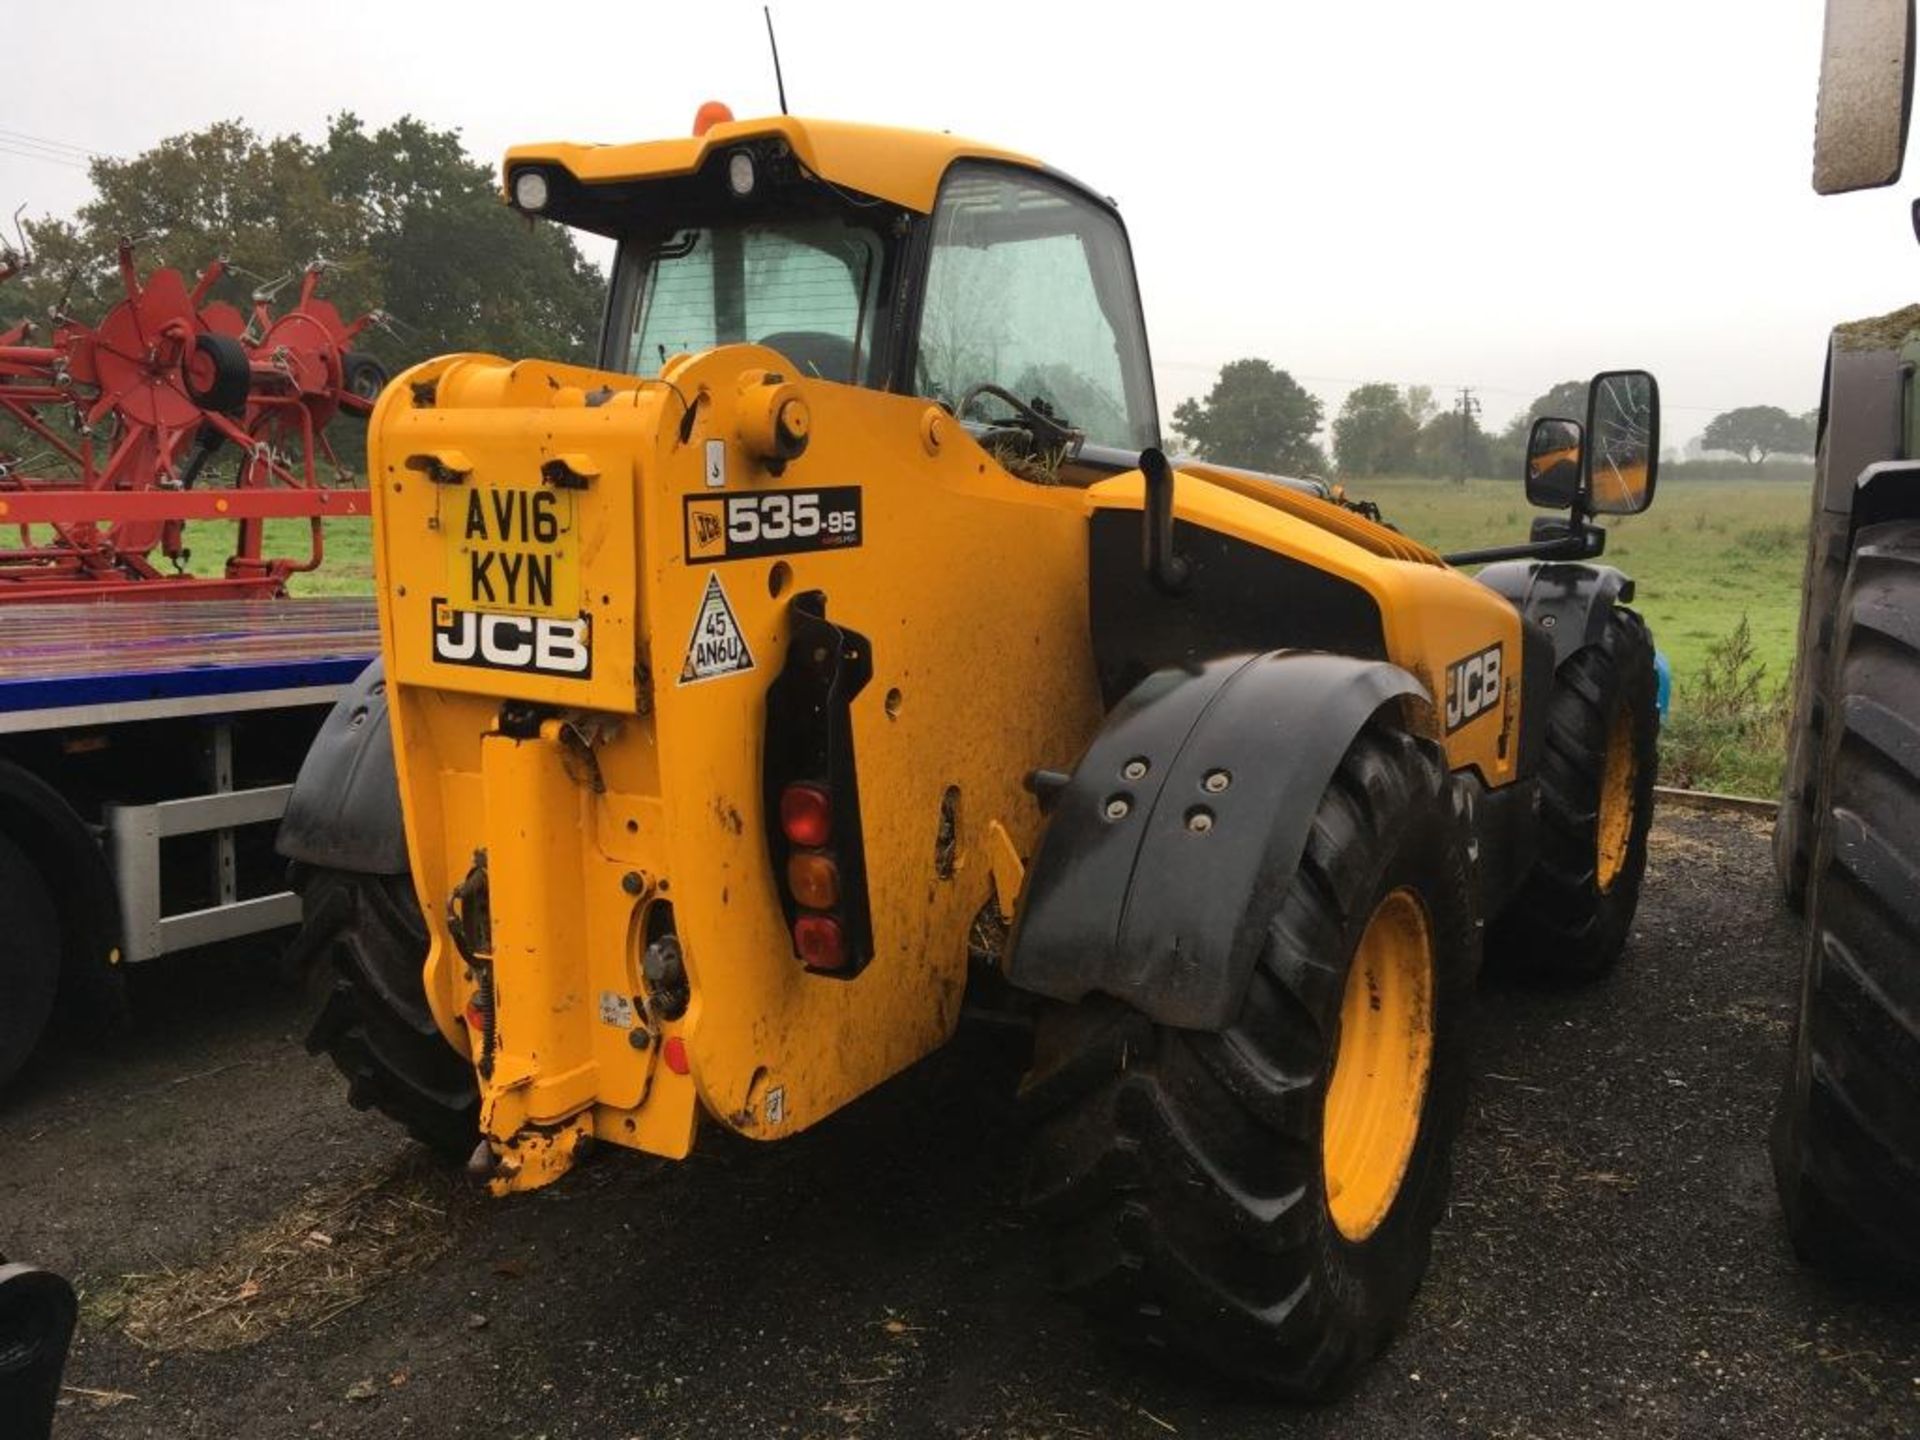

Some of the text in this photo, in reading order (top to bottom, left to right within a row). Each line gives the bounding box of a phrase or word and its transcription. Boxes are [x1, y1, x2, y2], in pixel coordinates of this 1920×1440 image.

[465, 488, 558, 543] AV16
[472, 550, 553, 606] KYN
[436, 612, 588, 672] JCB
[706, 612, 726, 636] 45
[696, 637, 738, 667] AN6U
[1447, 648, 1500, 728] JCB
